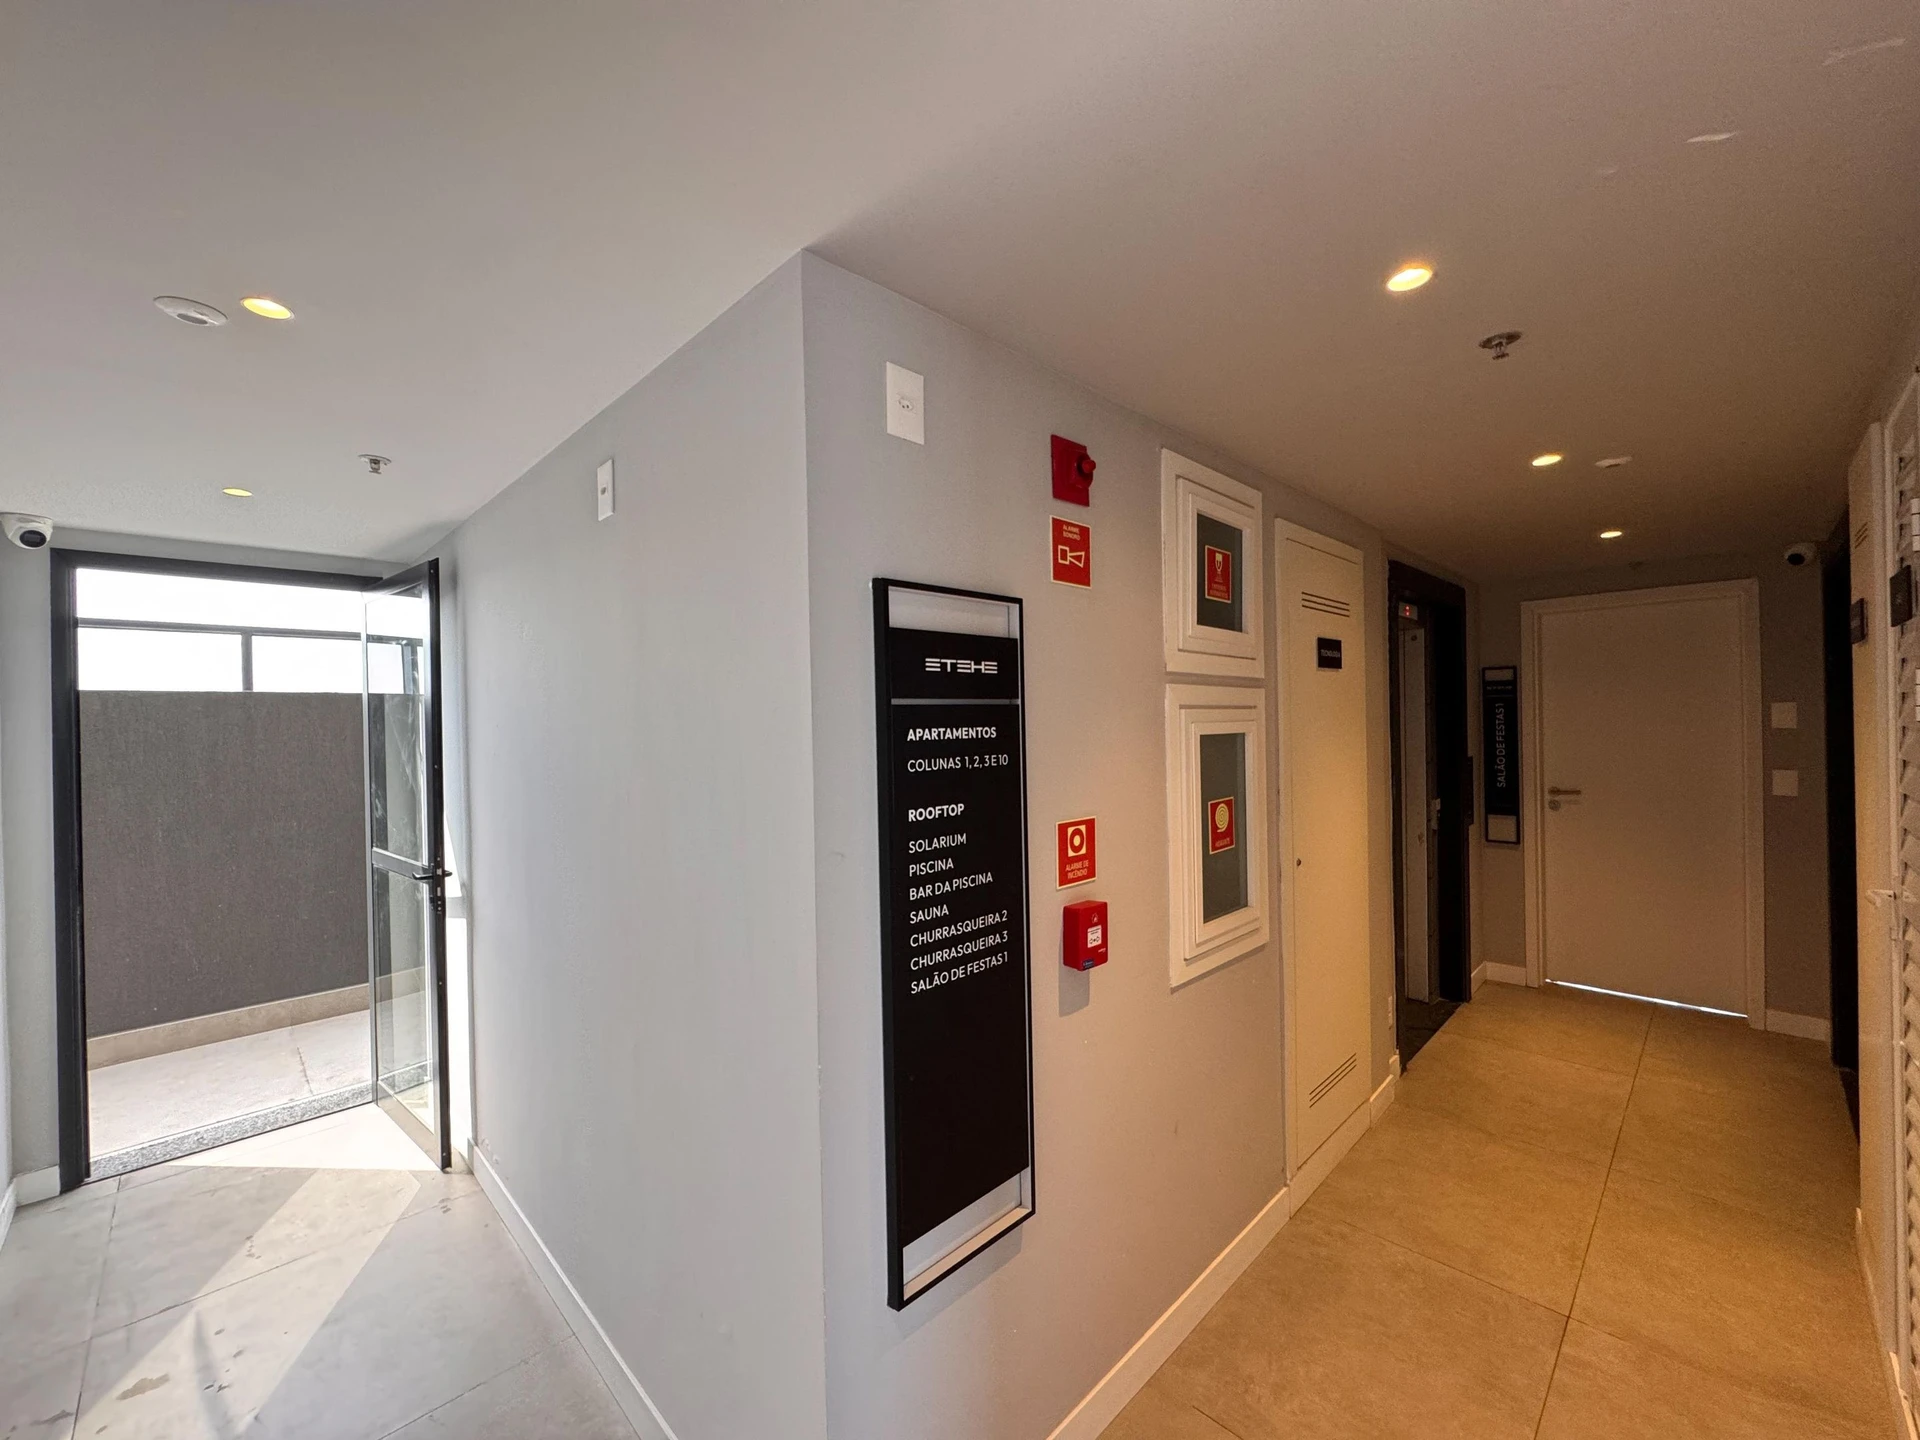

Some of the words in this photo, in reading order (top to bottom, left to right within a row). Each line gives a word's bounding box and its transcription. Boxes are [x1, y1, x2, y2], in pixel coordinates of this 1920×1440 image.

[907, 726, 997, 742] APARTAMENTOS
[1495, 708, 1505, 742] FESTAS
[1496, 743, 1505, 756] DE
[907, 756, 961, 773] COLUNAS
[1495, 757, 1506, 788] SALÃO
[908, 803, 965, 822] ROOFTOP
[908, 833, 967, 854] SOLARIUM
[909, 858, 954, 877] PISCINA
[1065, 861, 1083, 872] ALARME
[1083, 859, 1089, 868] DE
[909, 883, 933, 901] BAR
[935, 881, 951, 896] DA
[953, 871, 993, 891] PISCINA
[909, 903, 949, 924] SAUNA
[910, 912, 1001, 947] CHURRASQUEIRA
[1001, 910, 1008, 922] 2
[910, 932, 1001, 971] CHURRASQUEIRA
[1002, 930, 1009, 943] 3
[910, 971, 949, 994] SALÃO
[951, 966, 966, 981] DE
[967, 953, 1003, 975] FESTAS
